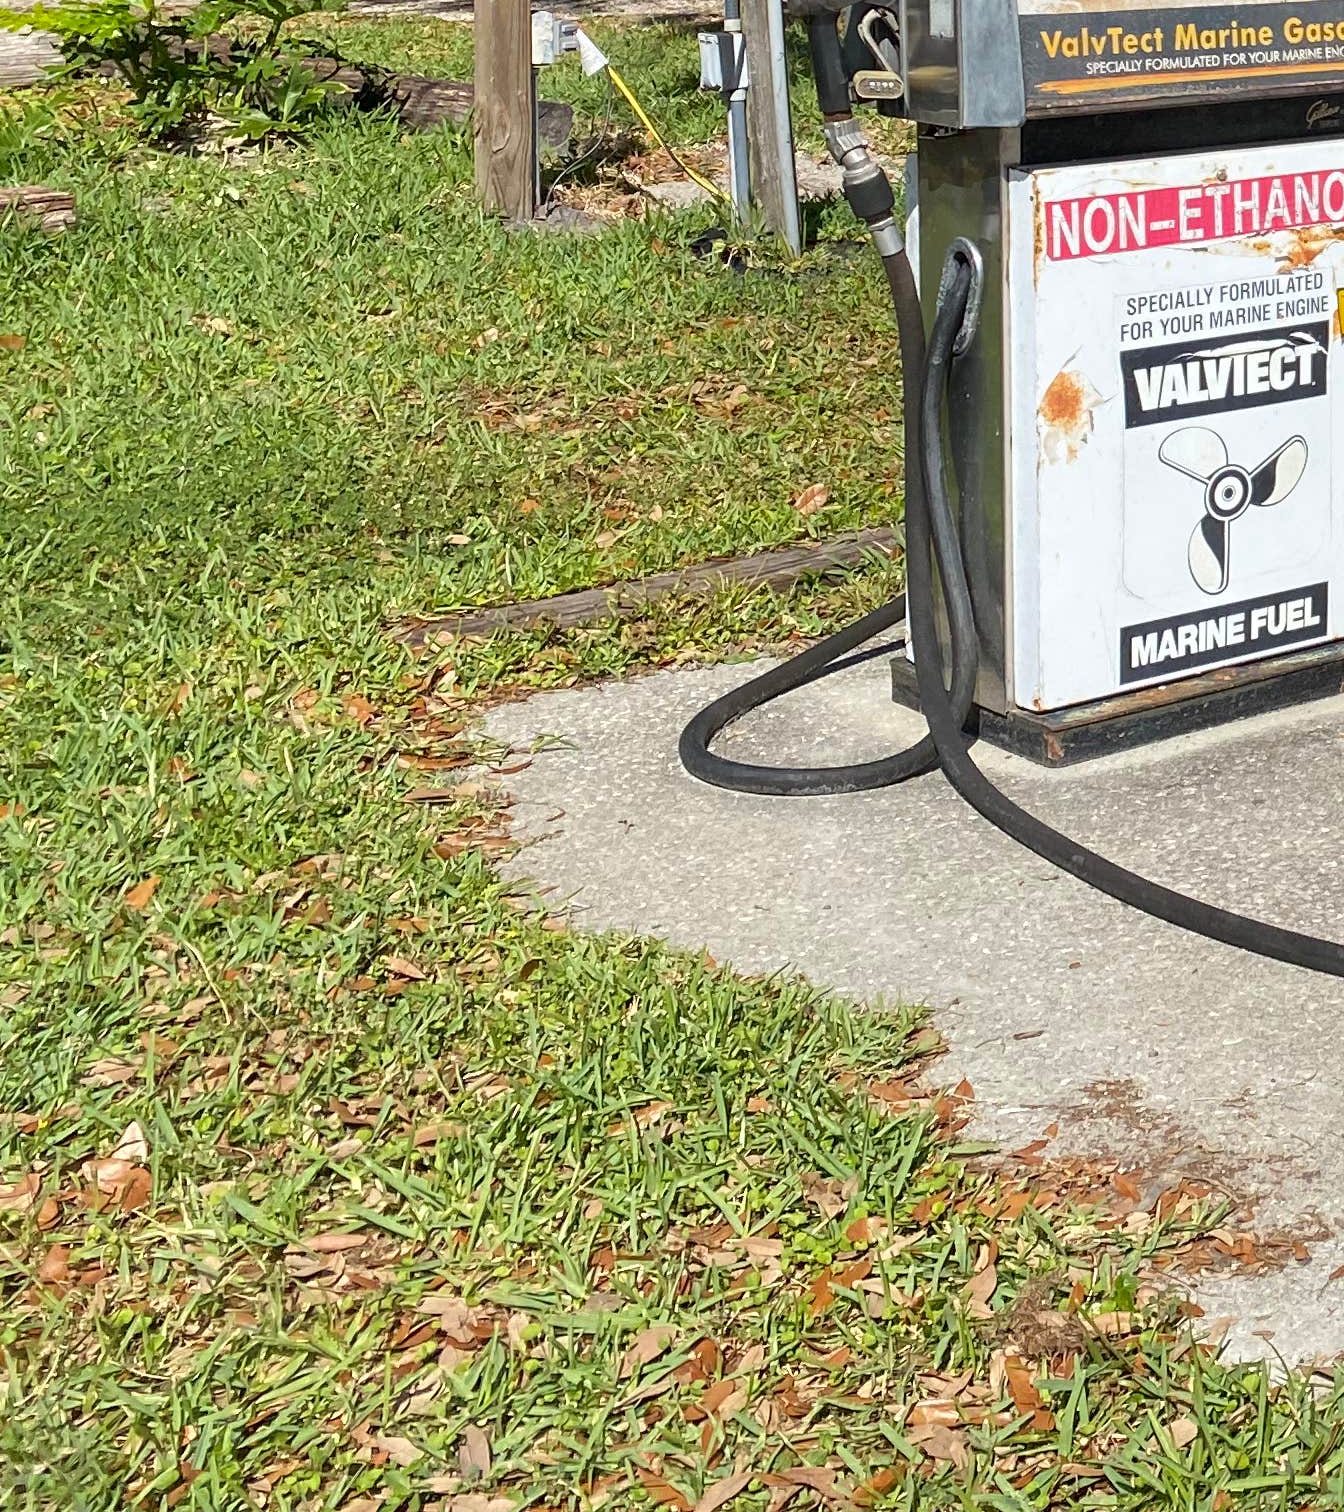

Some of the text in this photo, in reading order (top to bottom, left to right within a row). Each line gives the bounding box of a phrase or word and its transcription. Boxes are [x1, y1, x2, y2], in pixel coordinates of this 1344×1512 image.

[1040, 27, 1163, 58] ValvTect
[1174, 21, 1273, 52] Marine
[1086, 59, 1143, 76] SPECIALLY
[1145, 53, 1220, 73] FORMULATED
[1223, 52, 1248, 67] FOR
[1249, 49, 1281, 65] YOUR
[1282, 47, 1323, 63] MARINE
[1126, 273, 1323, 316] SPECIALLY FORMULATED
[1120, 295, 1329, 342] FOR YOUR MARINE ENGINE
[1131, 596, 1320, 669] MARINE FUEL
